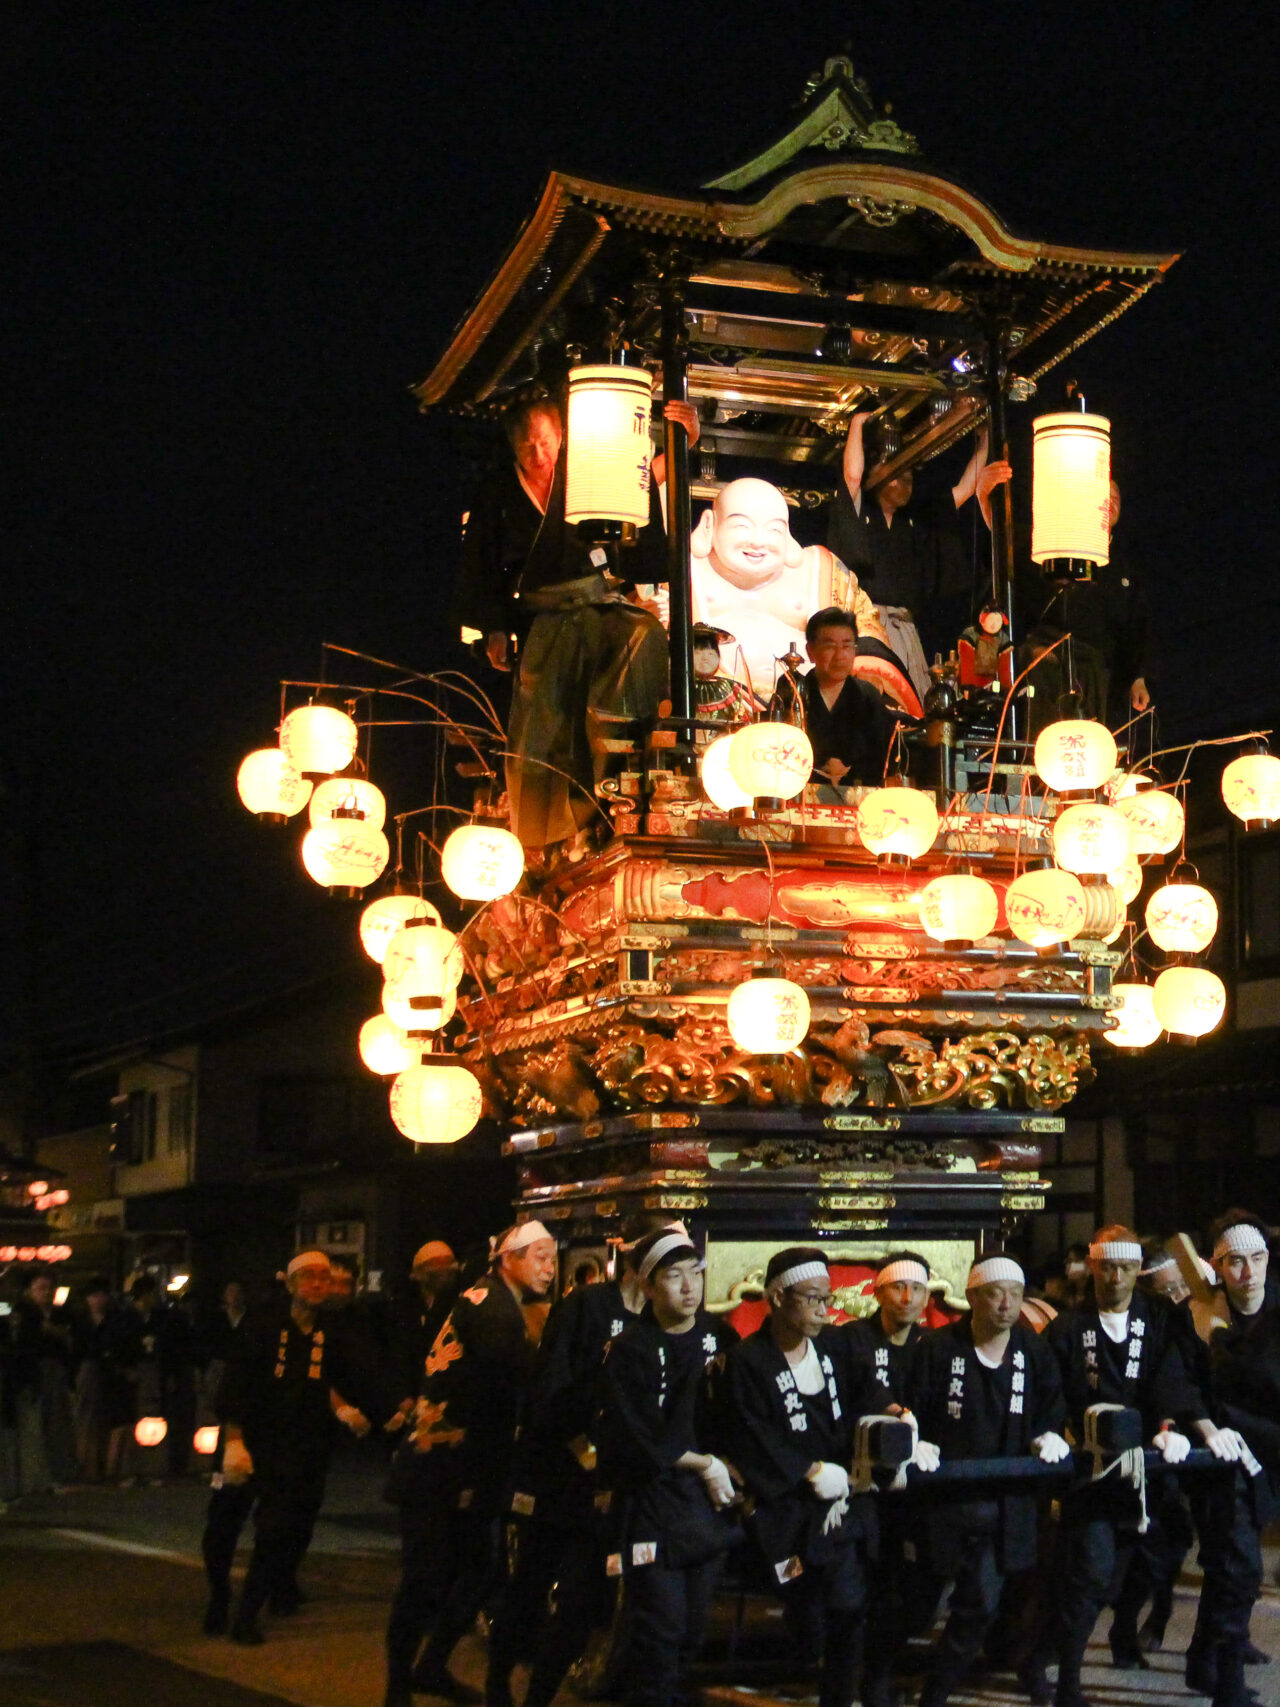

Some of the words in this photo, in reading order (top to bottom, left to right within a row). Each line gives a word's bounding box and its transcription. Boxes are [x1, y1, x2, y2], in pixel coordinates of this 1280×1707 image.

[1125, 1318, 1146, 1379] 布袋組
[775, 1370, 808, 1432] 出丸町
[947, 1356, 965, 1420] 出丸町
[1009, 1350, 1025, 1414] 布袋組
